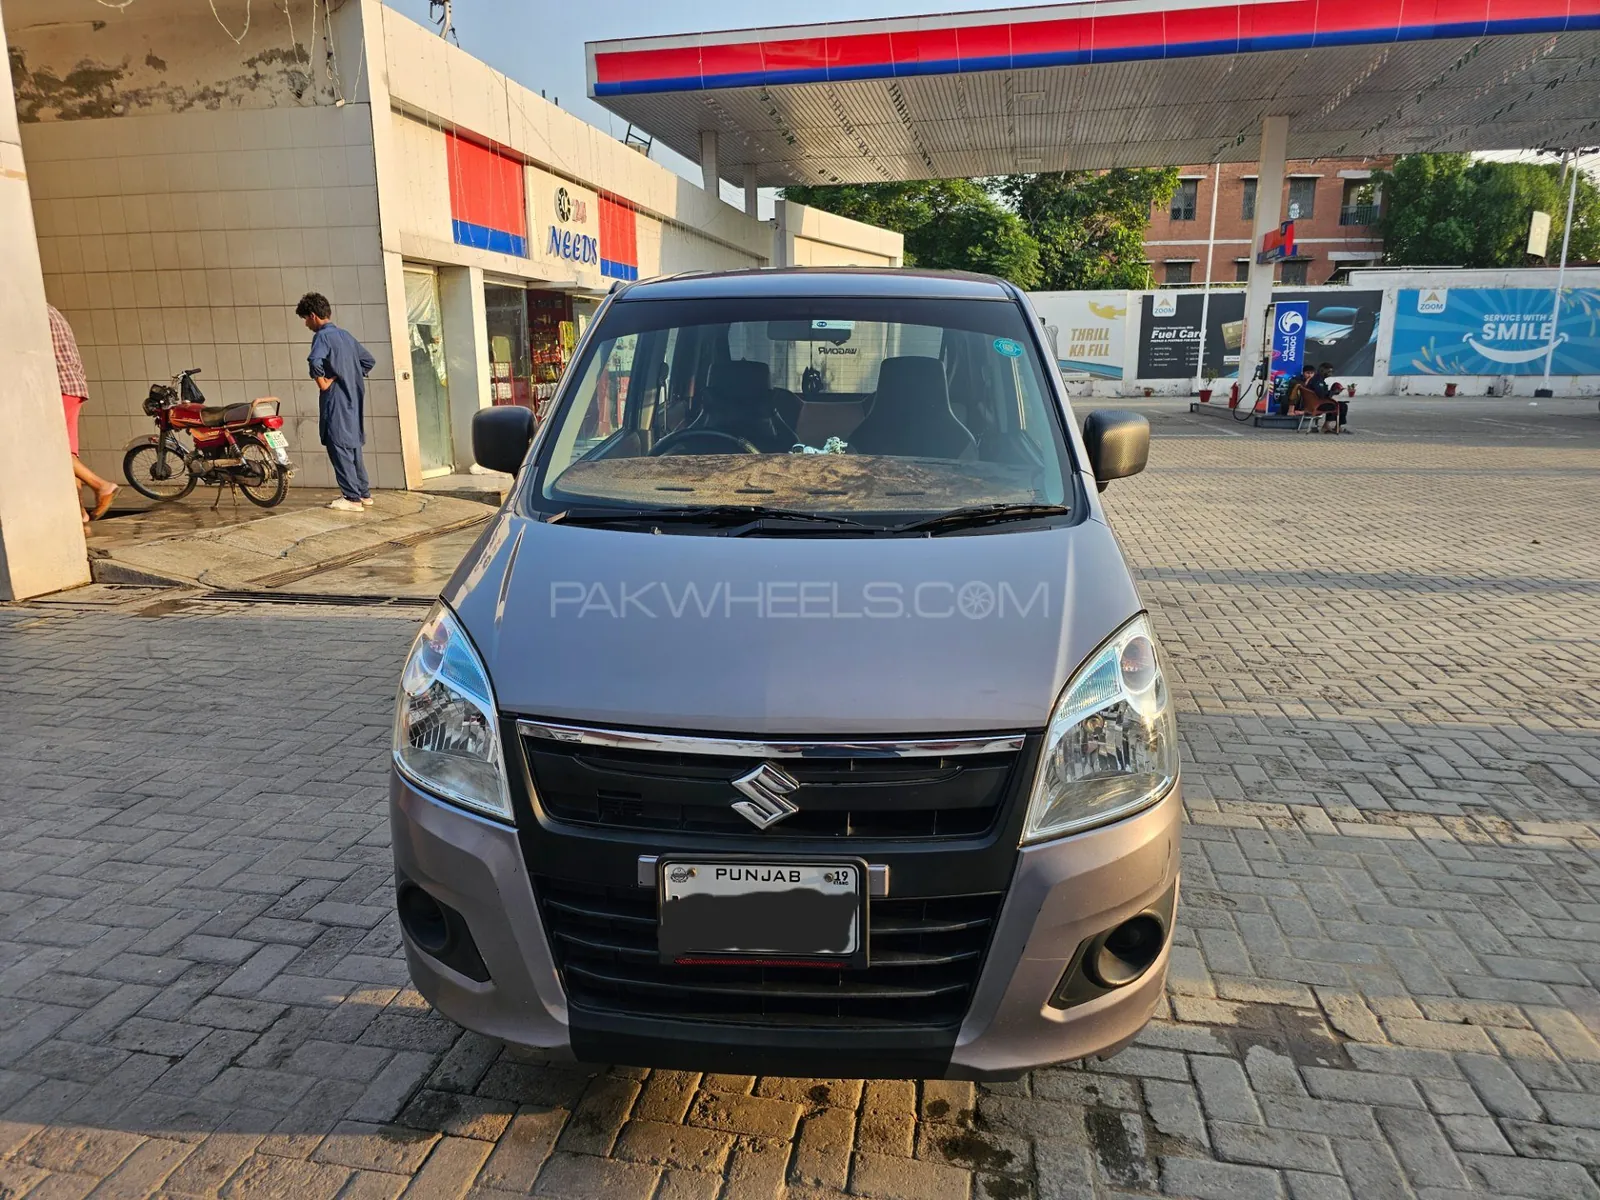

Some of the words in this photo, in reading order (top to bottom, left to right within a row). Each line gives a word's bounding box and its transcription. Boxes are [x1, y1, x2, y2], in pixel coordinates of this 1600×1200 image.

[548, 225, 598, 265] NEEDS
[1421, 303, 1444, 311] ZOOM
[1483, 314, 1521, 322] SERVICE
[1522, 313, 1547, 321] WITH
[1070, 328, 1110, 341] THRILL
[1151, 330, 1177, 339] Fuel
[1481, 322, 1554, 340] SMILE
[1069, 344, 1086, 357] KA
[1088, 344, 1110, 357] FILL
[1288, 335, 1297, 362] ADNOC
[715, 868, 801, 882] PUNJAB
[834, 870, 849, 881] 19
